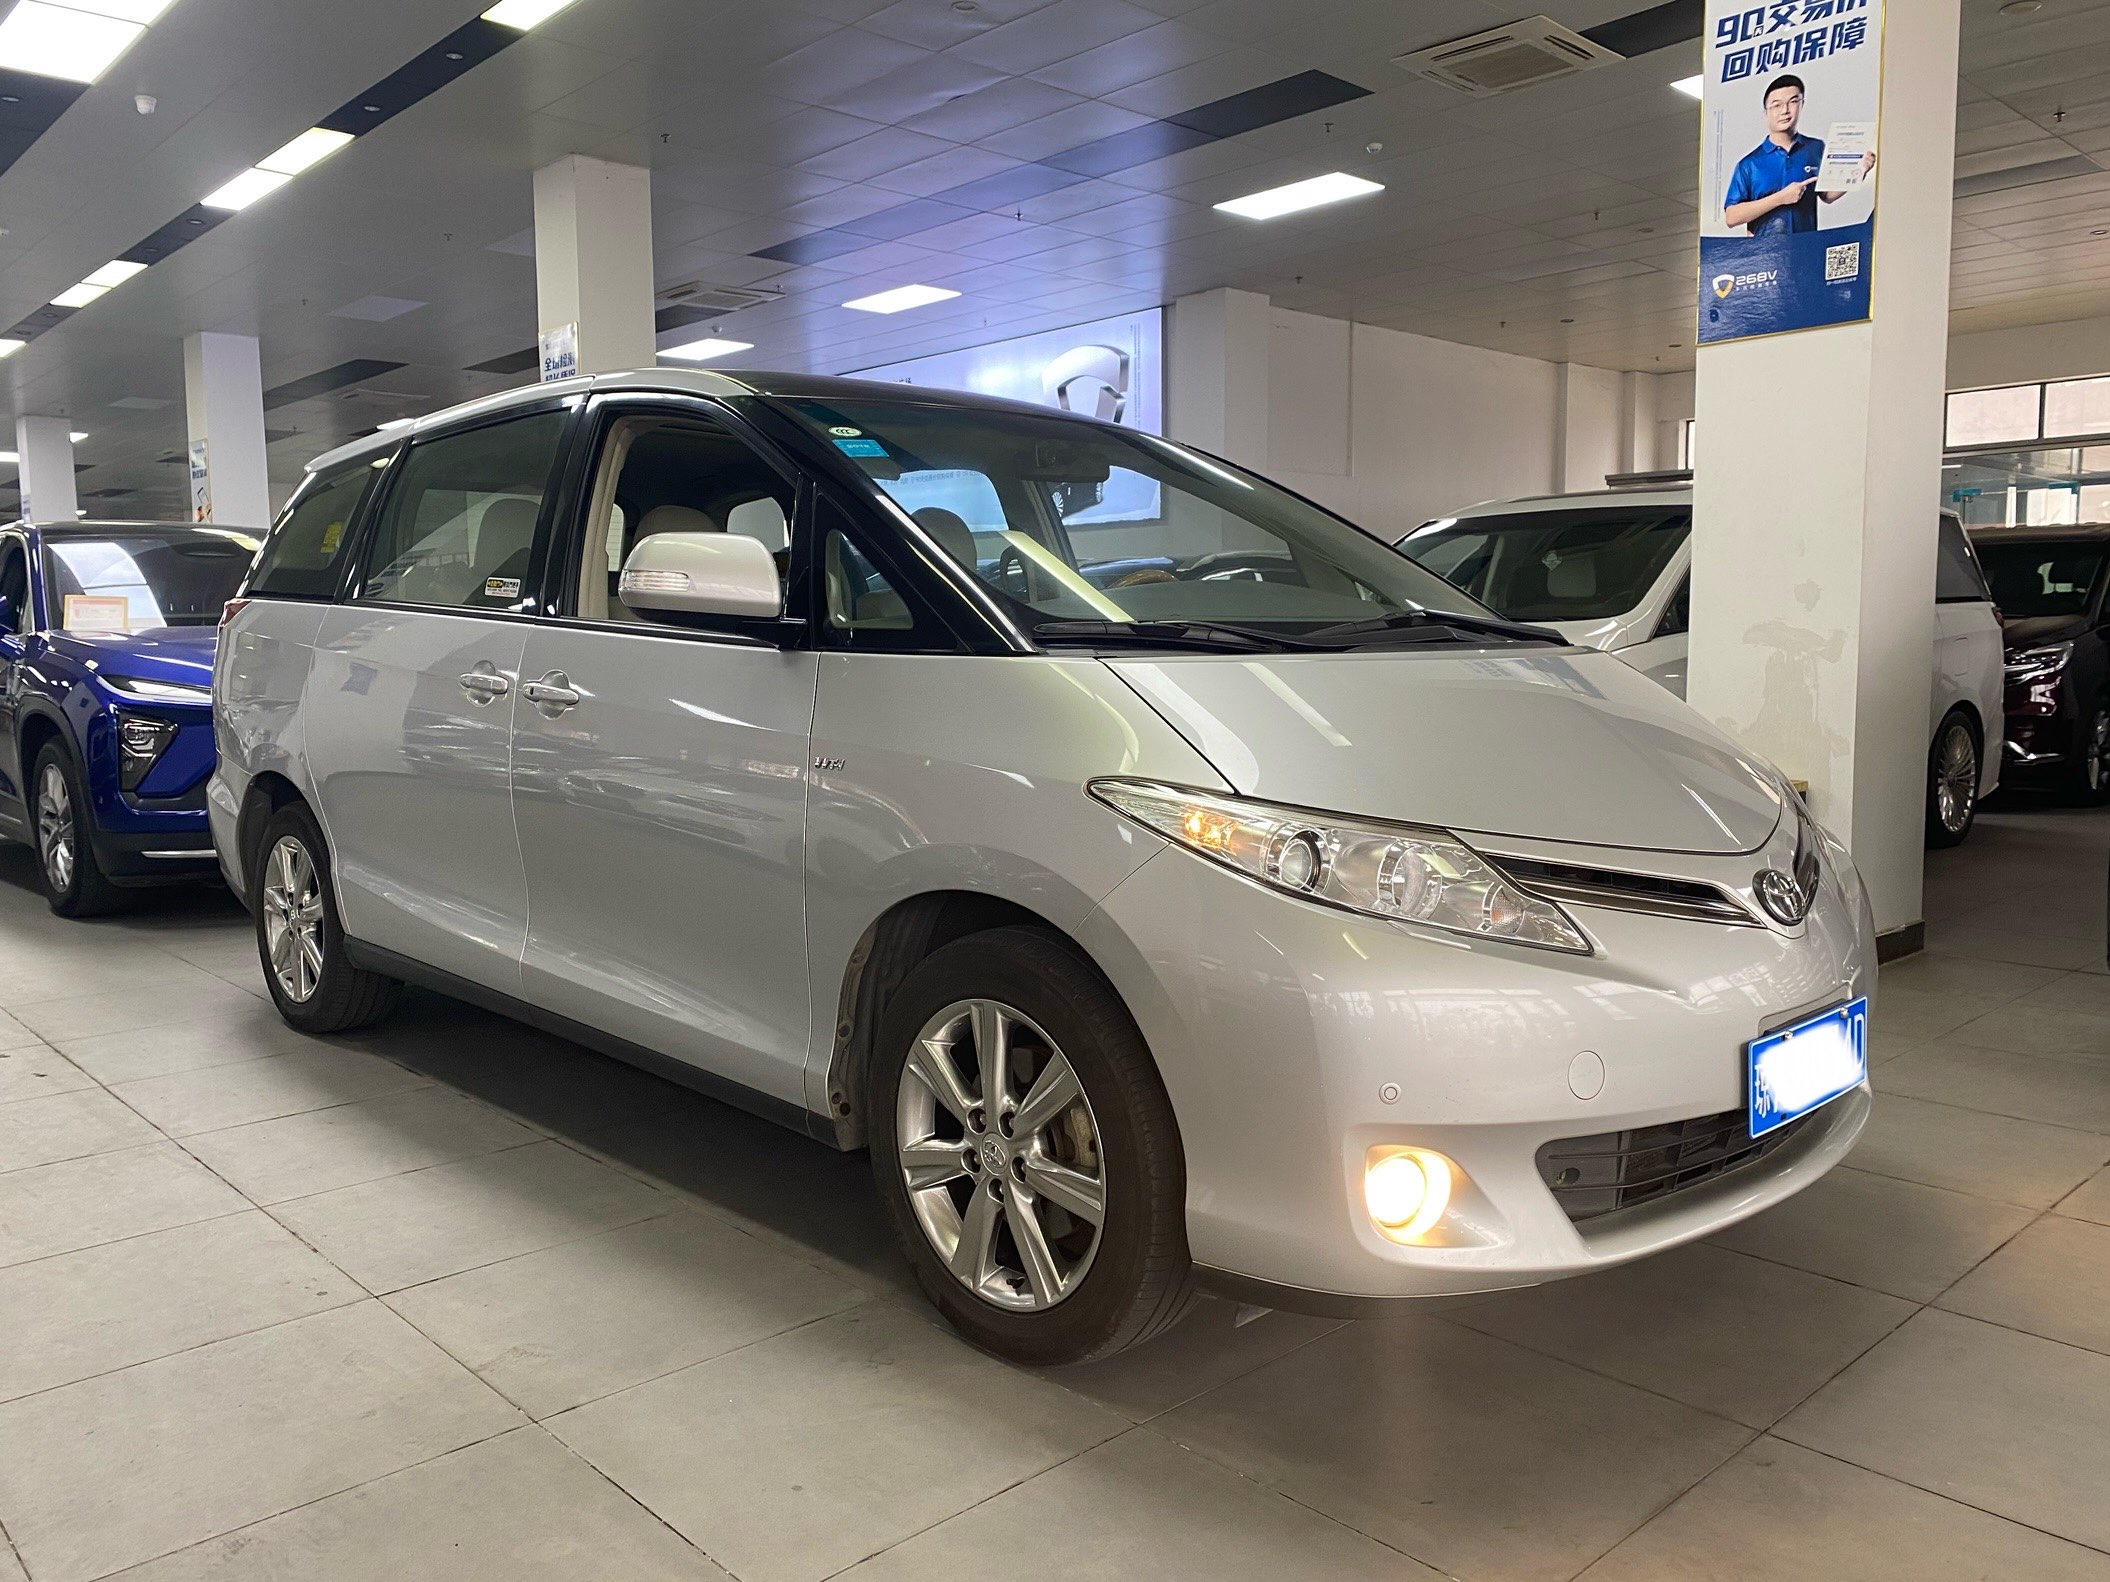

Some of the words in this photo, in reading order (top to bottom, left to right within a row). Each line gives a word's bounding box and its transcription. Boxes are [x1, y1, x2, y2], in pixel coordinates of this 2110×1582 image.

[1721, 16, 1868, 83] 回购保障
[1735, 269, 1778, 286] 268V
